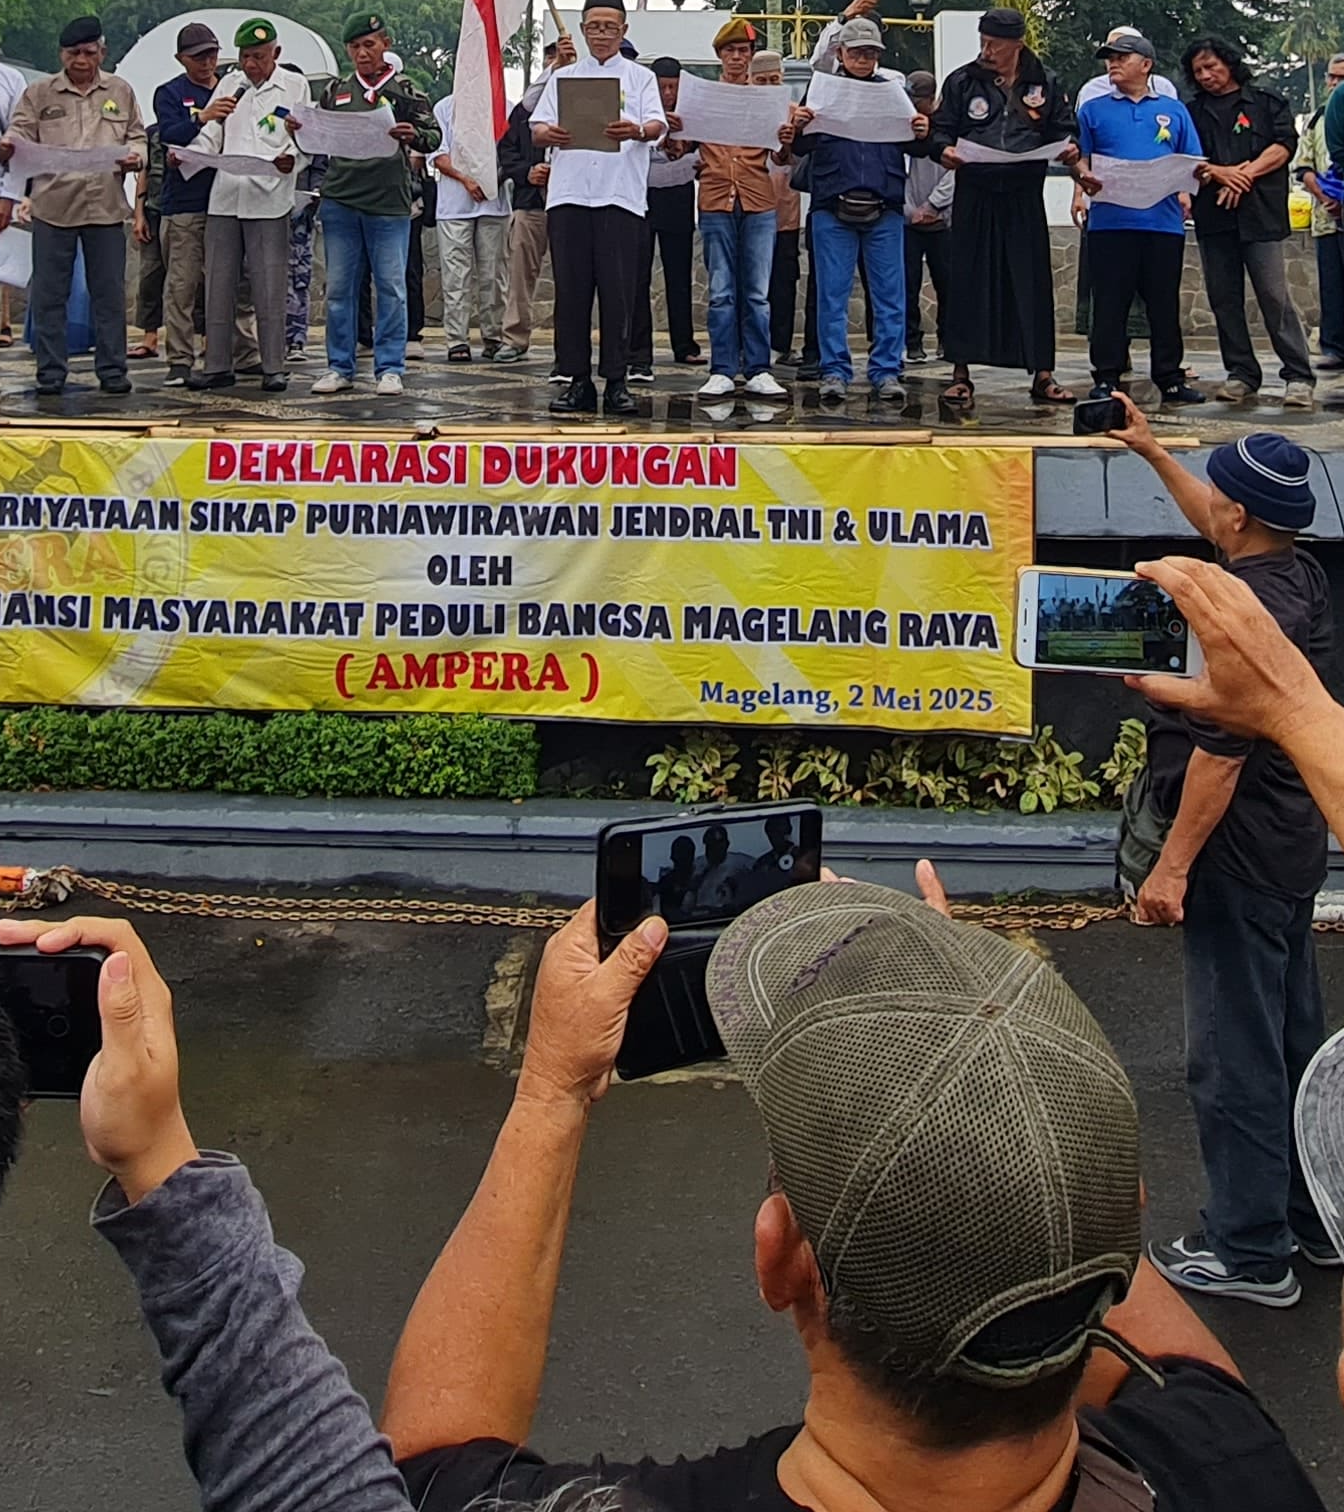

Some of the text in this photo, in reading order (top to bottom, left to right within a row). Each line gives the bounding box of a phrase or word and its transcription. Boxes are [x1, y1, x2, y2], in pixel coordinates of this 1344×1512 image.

[207, 441, 468, 484] DEKLARASI
[482, 444, 737, 487] DUKUNGAN
[188, 499, 297, 534] SIKAP
[305, 502, 599, 537] PURNAWIRAWAN
[608, 505, 761, 540] JENDRAL
[766, 508, 822, 542] TNI
[832, 509, 857, 543] &
[868, 510, 991, 548] ULAMA
[426, 554, 513, 587] OLEH
[102, 596, 365, 636] MASYARAKAT
[374, 602, 506, 638] PEDULI
[517, 602, 672, 641] BANGSA
[683, 605, 888, 647] MAGELANG
[898, 612, 1001, 651] RAYA
[365, 651, 570, 693] AMPERA
[699, 680, 993, 715] Magelang, 2 Mei 2025
